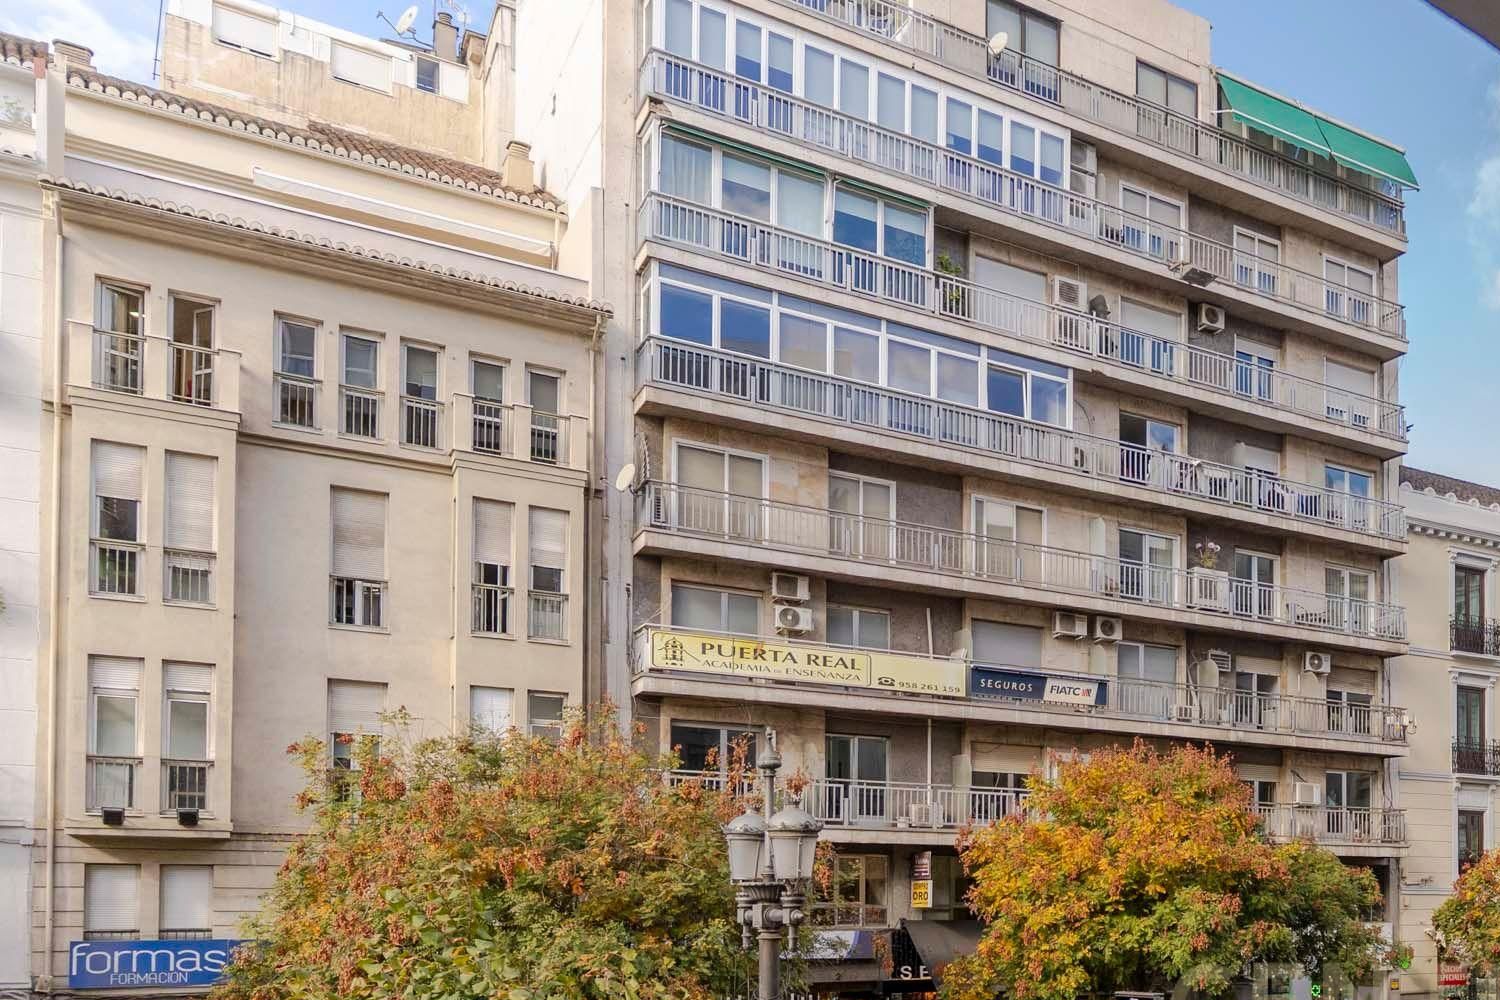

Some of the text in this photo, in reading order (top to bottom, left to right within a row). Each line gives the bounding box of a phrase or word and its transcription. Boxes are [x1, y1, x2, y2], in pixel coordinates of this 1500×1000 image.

[701, 641, 862, 671] PUERTA REAL
[702, 659, 772, 673] ACADEMIA
[898, 681, 961, 693] 958 261 159
[980, 678, 1081, 696] SEGUROS FIATC
[912, 891, 928, 901] ORO
[72, 943, 227, 976] formas
